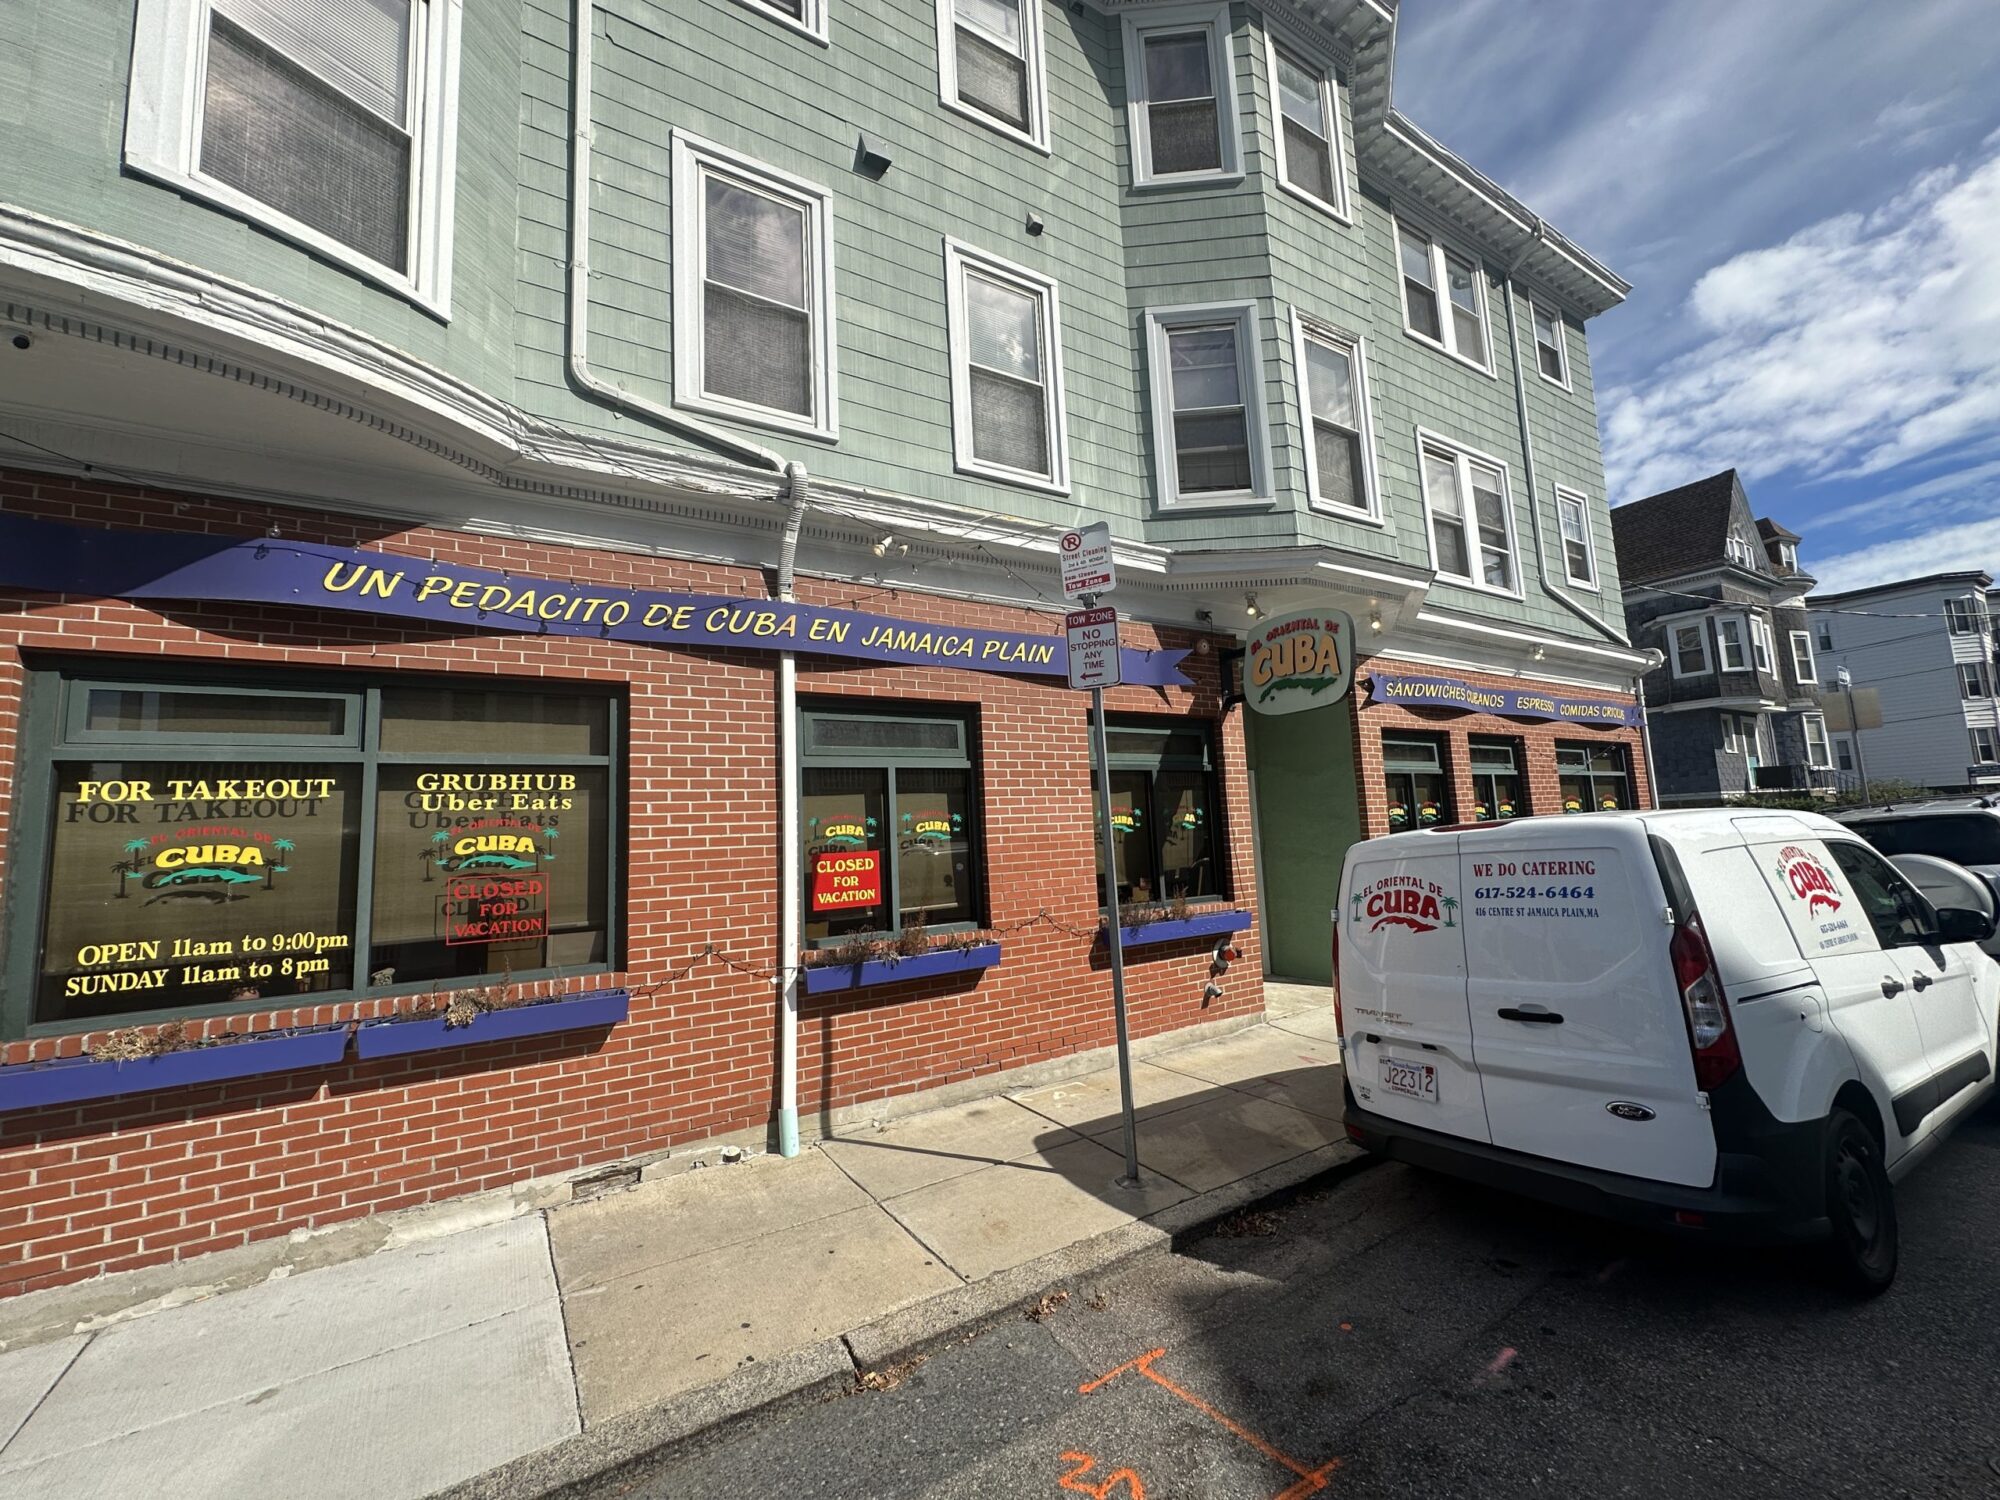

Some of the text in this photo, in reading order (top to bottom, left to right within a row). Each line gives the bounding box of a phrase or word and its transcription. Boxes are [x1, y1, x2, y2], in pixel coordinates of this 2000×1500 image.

[1062, 546, 1107, 562] Street Cleaning
[1067, 582, 1082, 590] Tow
[1085, 577, 1103, 586] Zone
[323, 562, 1054, 664] UN PEDACITO DE CUBA EN JAMAICA PLAIN
[1068, 610, 1114, 625] TOW ZONE
[1082, 629, 1101, 640] NO
[1324, 620, 1340, 634] DE
[1071, 638, 1115, 651] STOPPING
[1084, 650, 1103, 659] ANY
[1251, 633, 1342, 687] CUBA
[1083, 660, 1104, 670] TIME
[1386, 682, 1466, 701] SANDWICHES
[1517, 697, 1555, 713] ESPRESSO
[1560, 704, 1600, 717] COMIDAS
[416, 773, 576, 791] GRUBHUB
[77, 779, 336, 802] FOR TAKEOUT
[420, 793, 573, 812] Uber Eats
[1422, 807, 1437, 815] CUBA
[916, 820, 951, 833] CUBA
[1111, 815, 1134, 825] CUBA
[176, 826, 248, 838] ORIENTAL
[825, 824, 865, 837] CUBA
[454, 835, 536, 855] CUBA
[155, 844, 264, 868] CUBA
[816, 858, 875, 873] CLOSED
[1473, 860, 1596, 877] WE DO CATERING
[833, 876, 859, 888] FOR
[1363, 876, 1443, 898] EL ORIENTAL DE
[1789, 861, 1837, 899] CUBA
[454, 880, 543, 900] CLOSED
[818, 889, 875, 904] VACATION
[1475, 886, 1595, 899] 617-524-6464
[480, 902, 518, 917] FOR
[1366, 889, 1440, 920] CUBA
[1475, 907, 1486, 917] 416
[1488, 907, 1514, 917] CENTRE
[1516, 907, 1525, 917] ST
[1527, 907, 1560, 917] JAMAICA
[454, 918, 543, 937] VACATION
[77, 941, 160, 967] OPEN
[242, 935, 266, 952] to
[272, 931, 348, 955] 9:00pm
[65, 969, 168, 997] SUNDAY
[249, 961, 272, 978] to
[1354, 1007, 1402, 1019] TRANSIT
